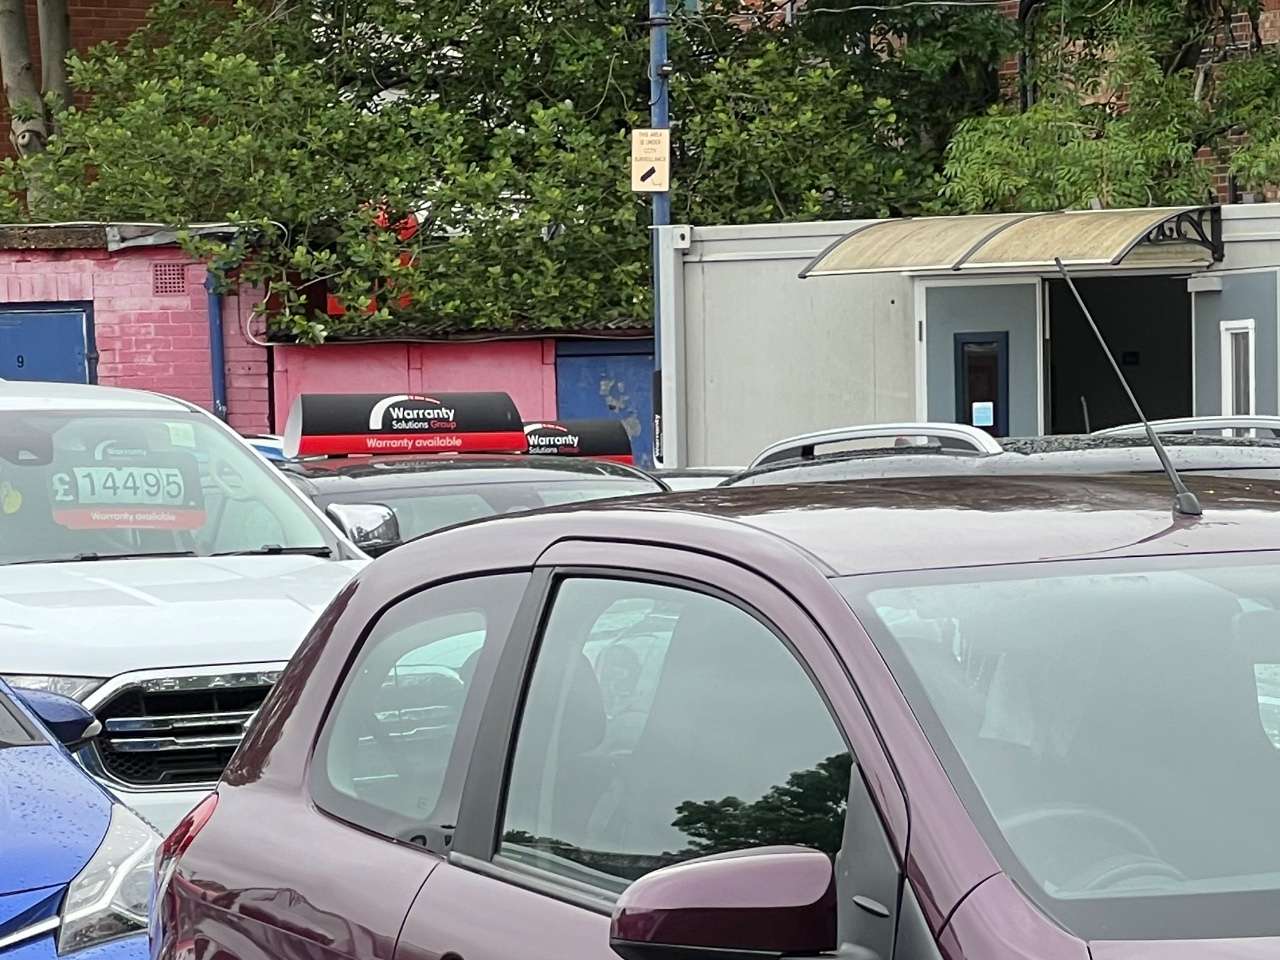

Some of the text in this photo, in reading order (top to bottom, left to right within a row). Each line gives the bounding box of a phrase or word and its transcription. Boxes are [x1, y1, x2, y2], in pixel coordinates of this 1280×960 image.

[16, 354, 25, 369] 9
[389, 407, 455, 421] Warranty
[392, 420, 457, 430] Solutions Group
[366, 436, 462, 449] Warranty available
[527, 434, 579, 447] Warranty
[528, 446, 558, 454] Solutions
[90, 511, 176, 522] Warranty available
